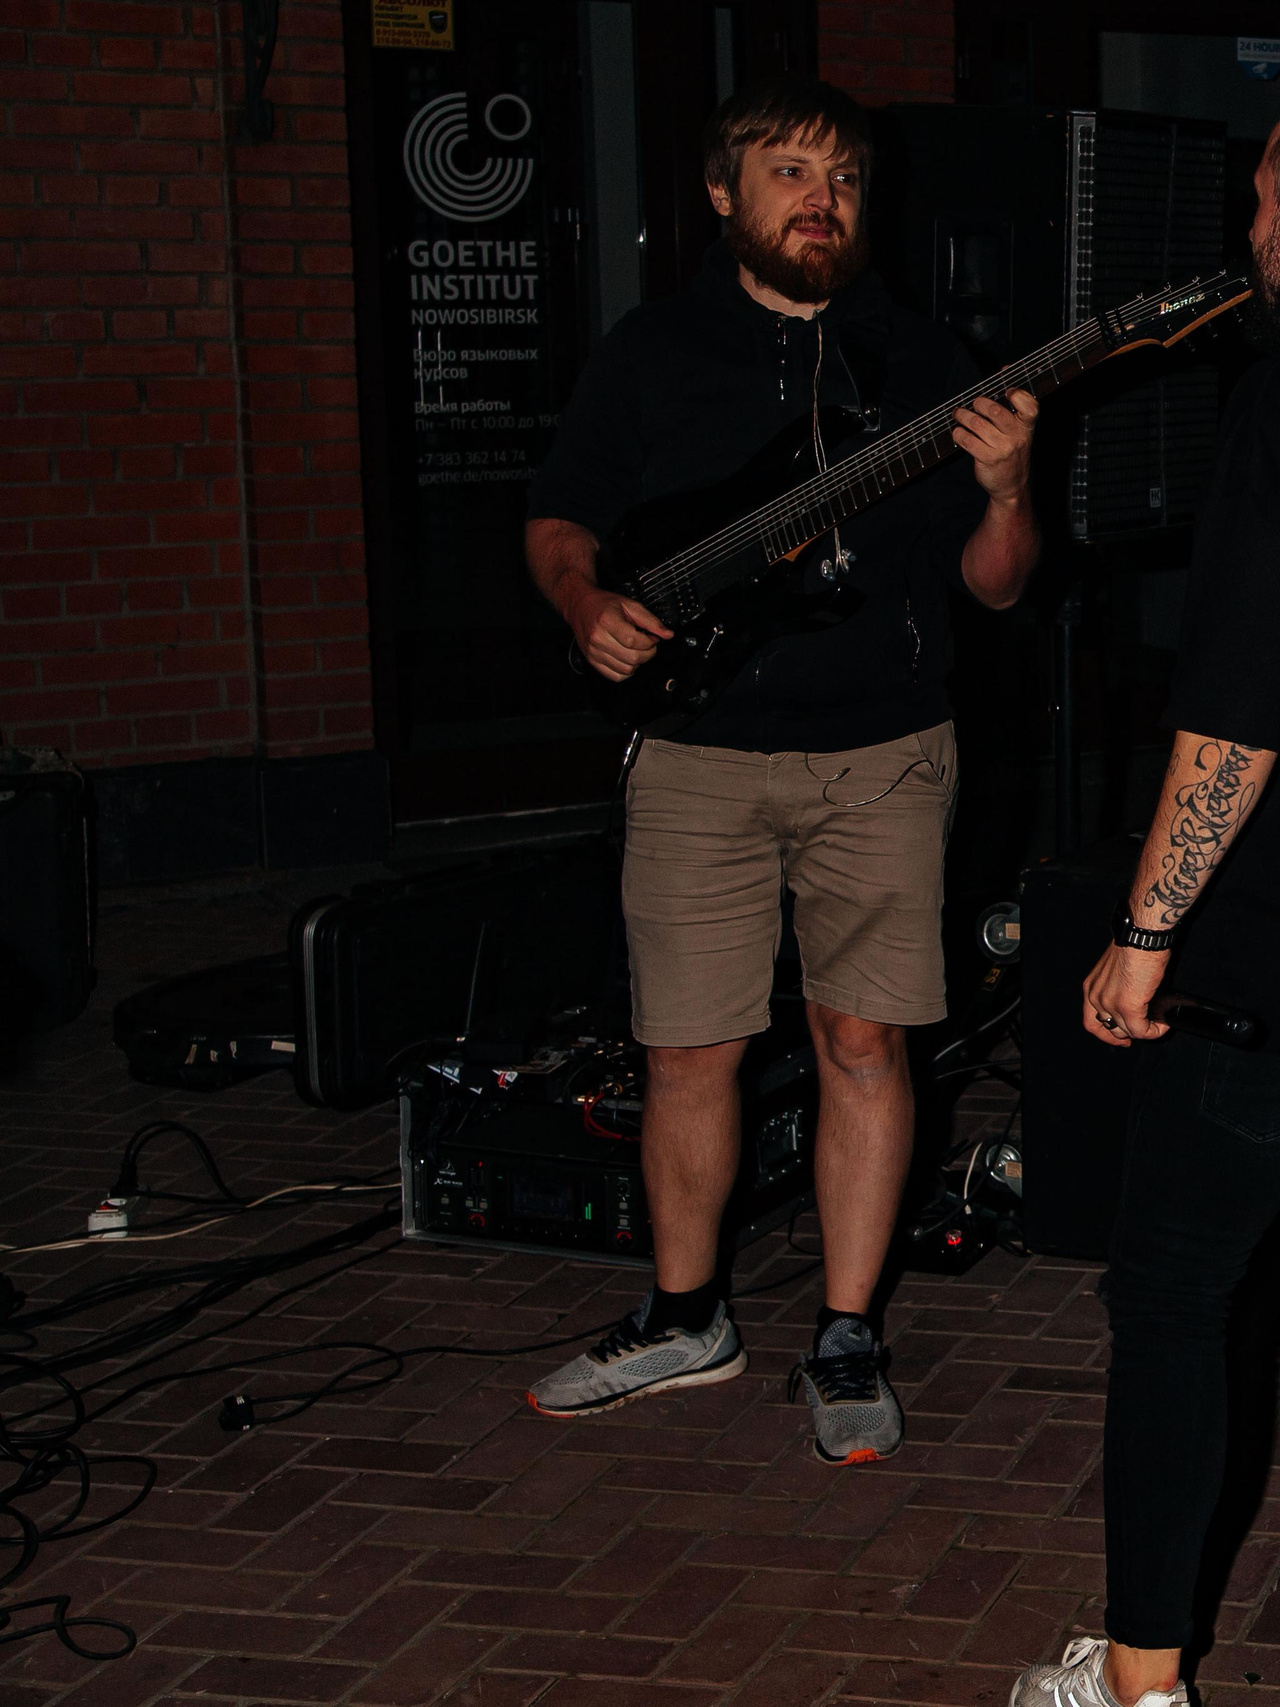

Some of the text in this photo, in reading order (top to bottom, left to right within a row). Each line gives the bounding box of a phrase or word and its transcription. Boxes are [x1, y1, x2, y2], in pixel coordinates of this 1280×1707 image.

[1240, 42, 1251, 51] 24
[408, 240, 538, 268] GOETHE
[410, 274, 539, 301] INSTITUT
[410, 308, 539, 325] NOWOSIBIRSK
[413, 348, 539, 362] Бюро языковых
[414, 367, 469, 382] курсов
[414, 399, 511, 415] Время работы
[415, 418, 434, 432] Пн
[451, 418, 467, 431] Пт
[483, 416, 515, 430] 10:00
[518, 417, 534, 431] до
[466, 452, 489, 465] 362
